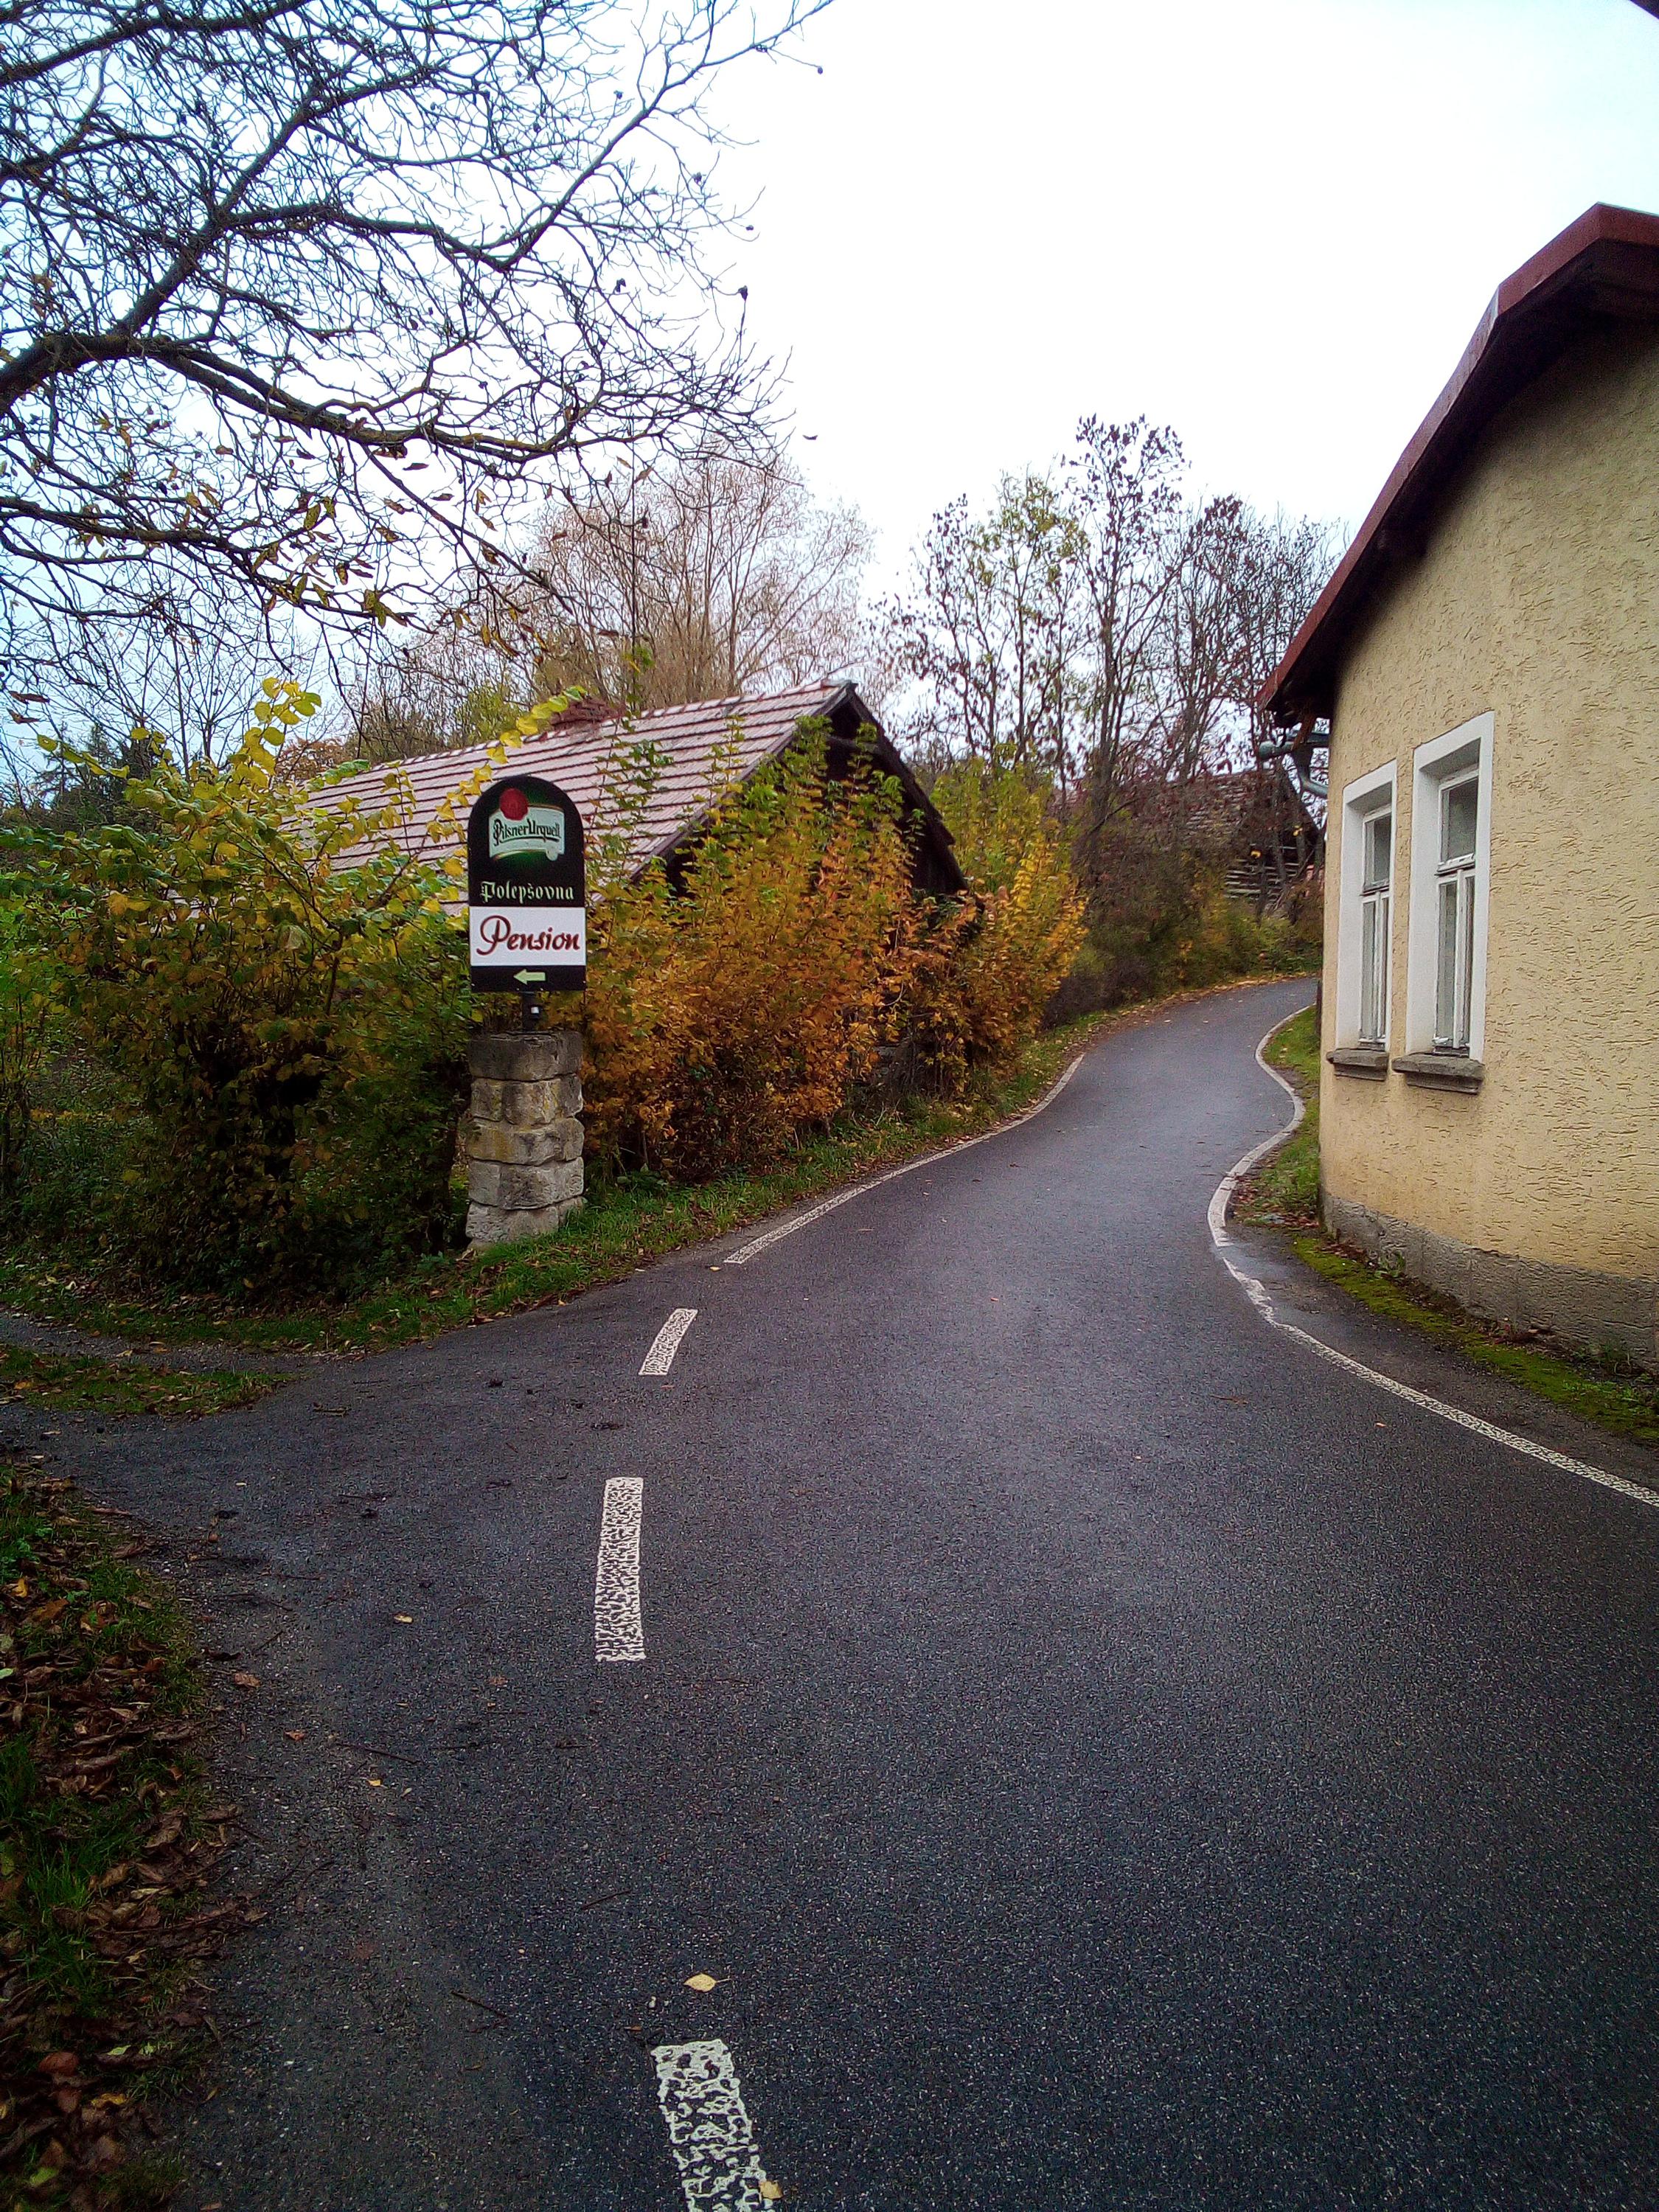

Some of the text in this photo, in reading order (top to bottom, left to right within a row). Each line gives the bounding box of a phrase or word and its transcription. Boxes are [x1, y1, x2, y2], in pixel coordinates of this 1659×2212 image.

[493, 817, 561, 846] Pilsner Urquell
[481, 880, 574, 904] Polepšovna
[476, 915, 580, 956] Pension
